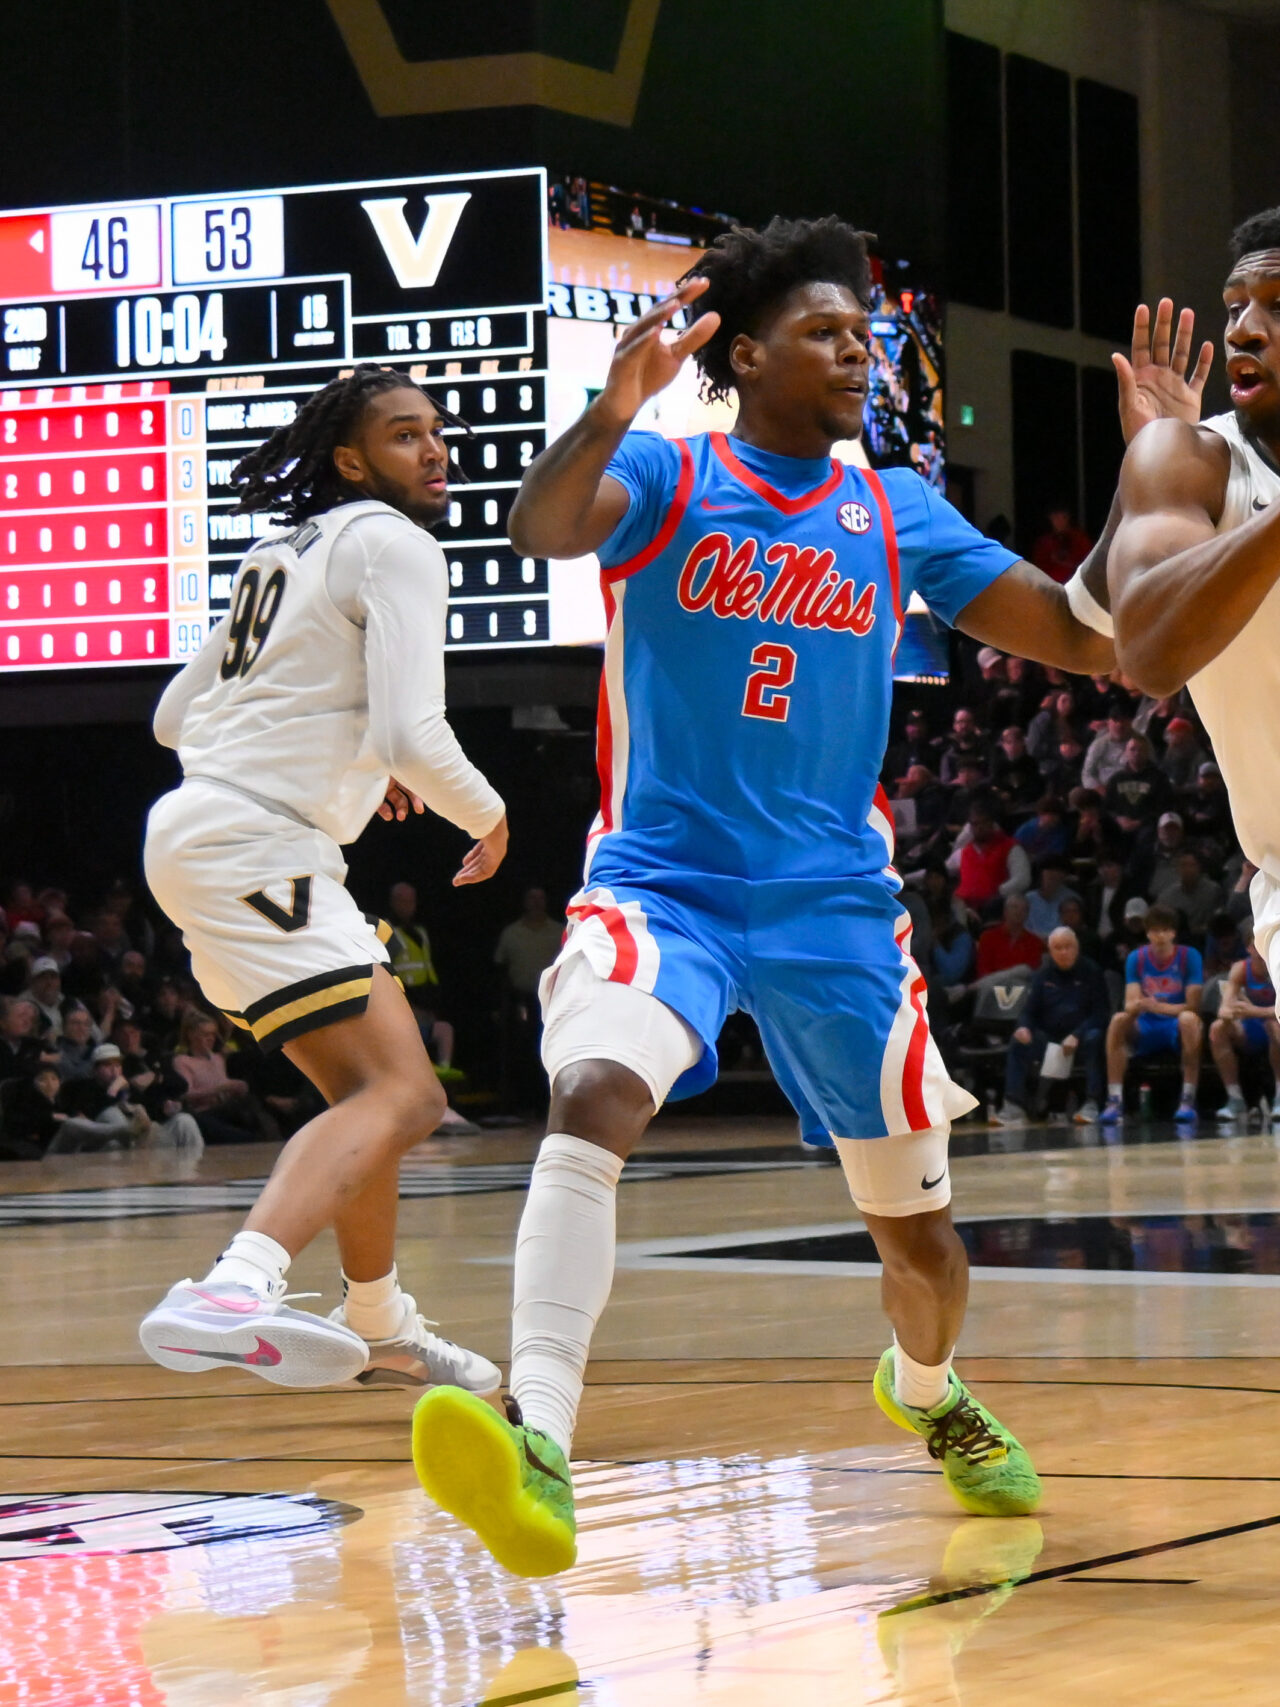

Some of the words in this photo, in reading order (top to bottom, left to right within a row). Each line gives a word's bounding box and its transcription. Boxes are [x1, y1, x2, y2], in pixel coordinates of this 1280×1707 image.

[81, 217, 128, 280] 46
[205, 207, 252, 271] 53
[360, 192, 472, 288] V
[4, 307, 47, 343] 2ND
[116, 293, 228, 368] 10:04
[302, 294, 328, 330] 15
[182, 460, 192, 488] 3
[839, 502, 871, 533] SEC
[181, 573, 198, 601] 10
[678, 532, 765, 620] Ole
[757, 541, 877, 637] Miss
[178, 624, 202, 653] 99
[220, 565, 288, 683] 99
[741, 641, 798, 723] 2
[236, 873, 314, 934] V
[993, 985, 1025, 1010] V
